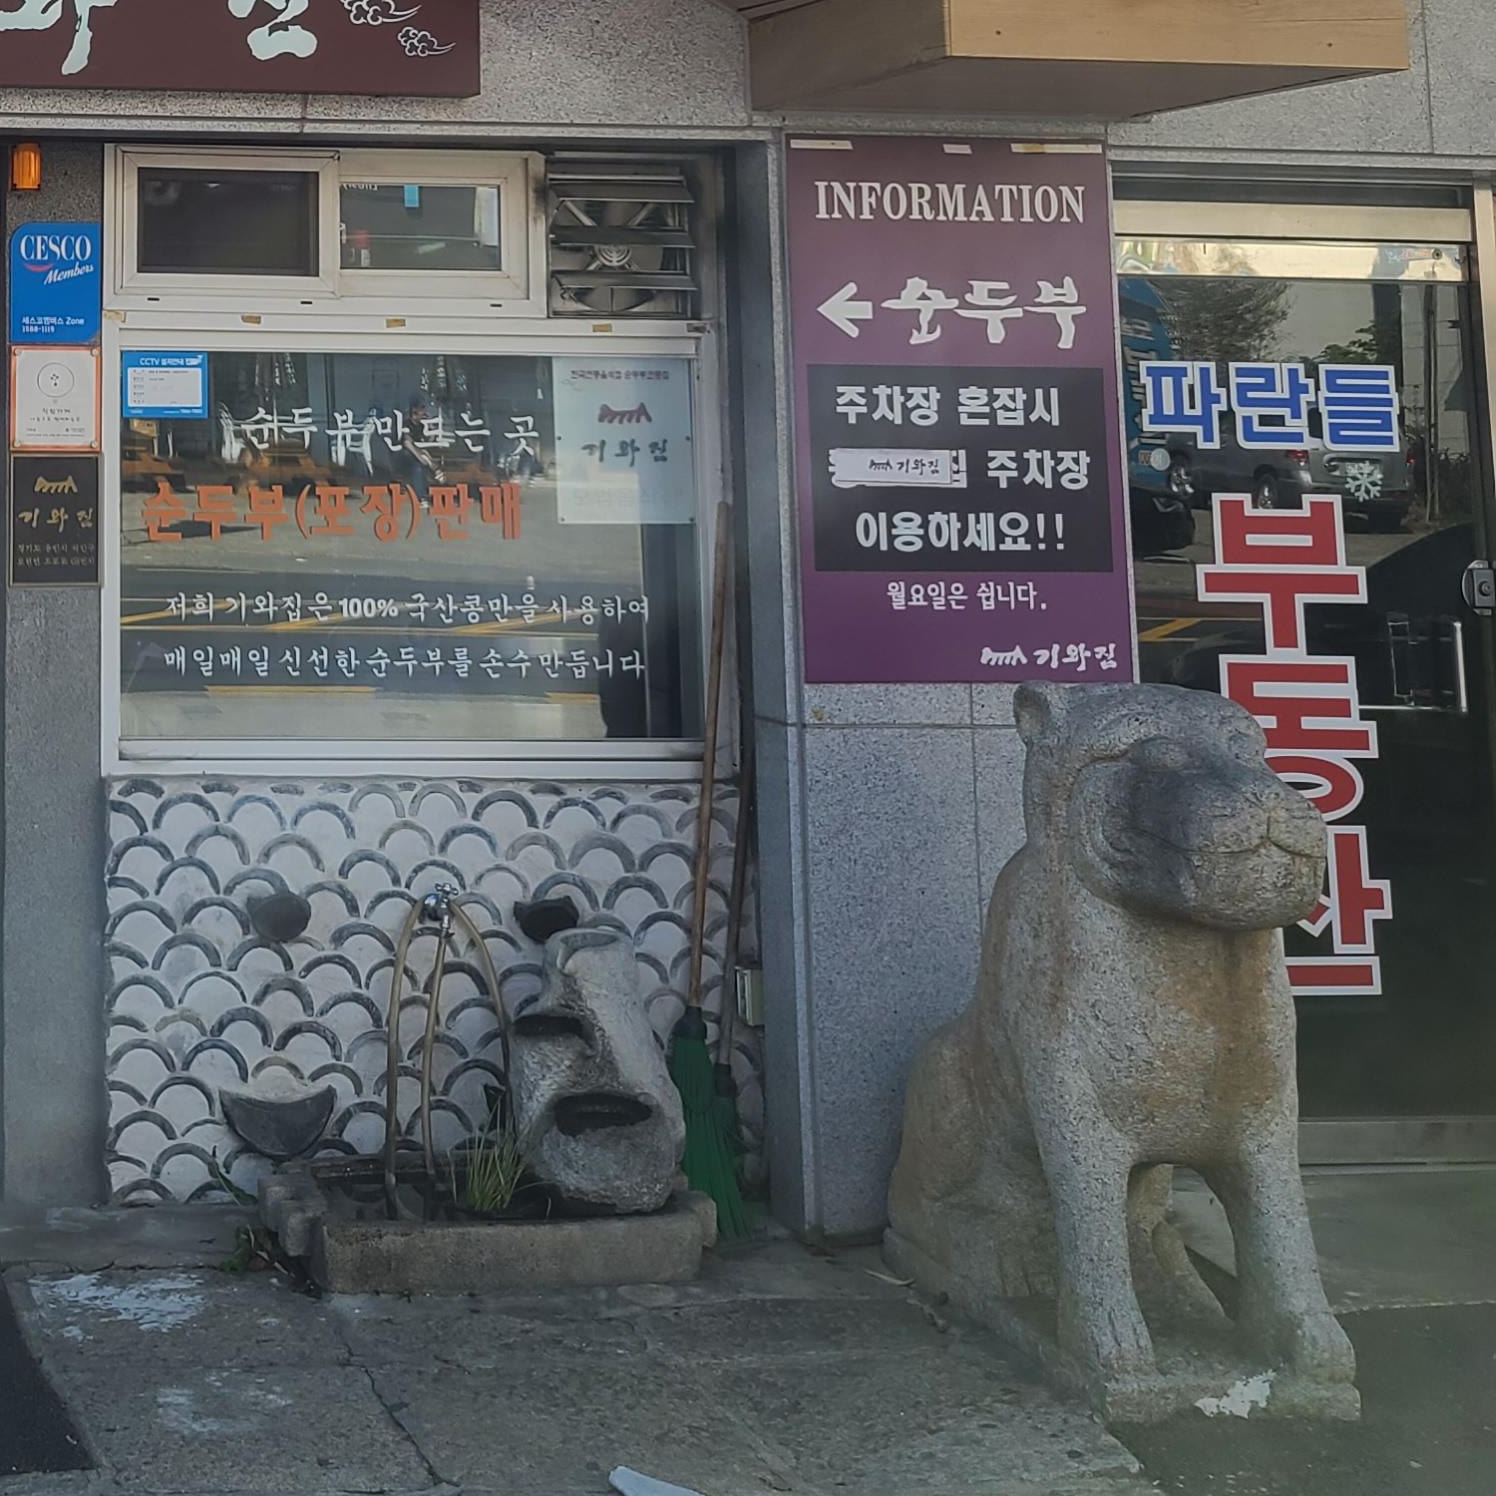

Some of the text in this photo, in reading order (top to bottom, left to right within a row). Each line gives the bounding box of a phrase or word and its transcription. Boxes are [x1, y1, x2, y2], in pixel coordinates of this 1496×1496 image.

[814, 181, 1085, 223] INFORMATION
[19, 234, 92, 262] CESCO
[43, 263, 95, 286] Members
[881, 276, 1087, 349] 순두부
[835, 385, 1060, 426] 주차장 혼잡시
[1139, 360, 1399, 451] 파란들
[581, 438, 668, 467] 기와집
[896, 457, 941, 476] 기와집
[986, 449, 1091, 491] 주차장
[856, 511, 1065, 552] 이용하세요!!
[165, 591, 215, 622] 저희
[338, 598, 399, 618] 100%
[887, 581, 1047, 610] 월요일은 쉽니다.
[163, 645, 646, 680] 매일매일 신선한 순두부를 손수 만듭니다
[1033, 642, 1118, 671] 기와집
